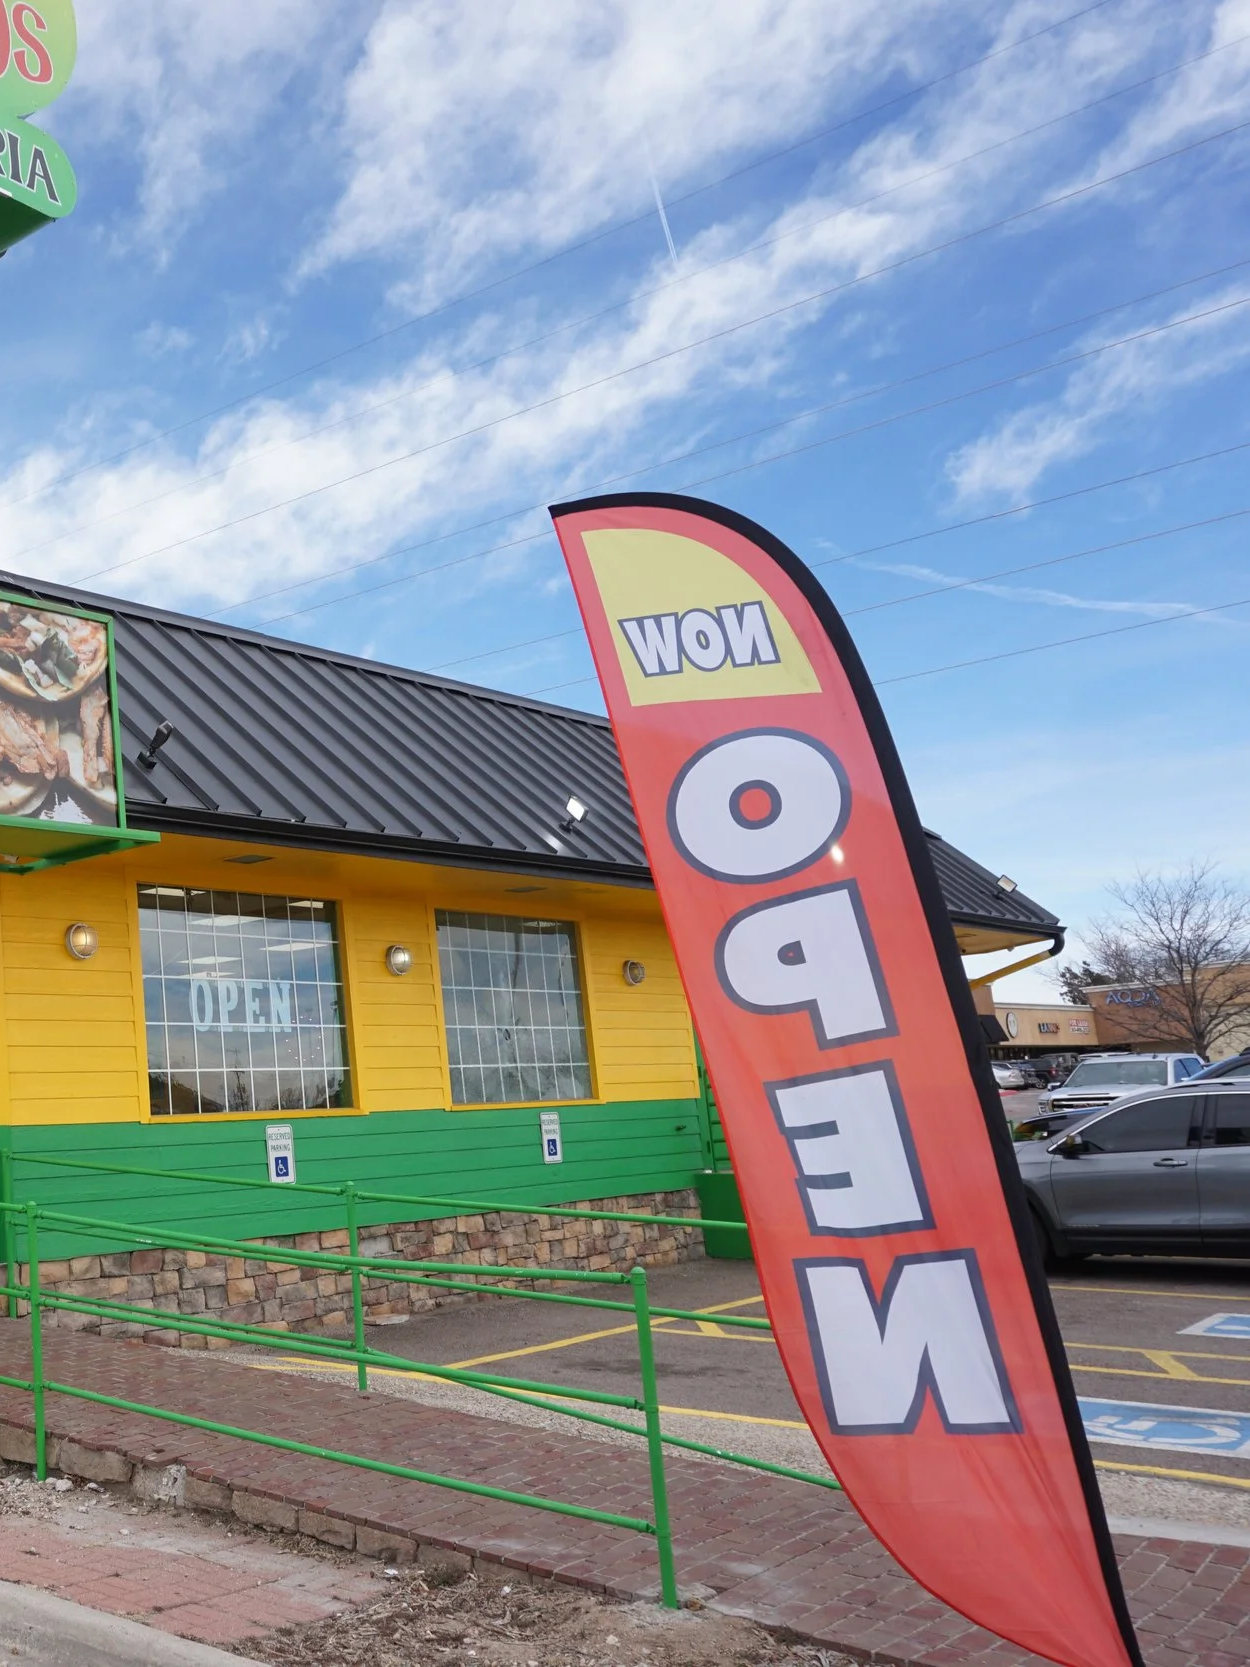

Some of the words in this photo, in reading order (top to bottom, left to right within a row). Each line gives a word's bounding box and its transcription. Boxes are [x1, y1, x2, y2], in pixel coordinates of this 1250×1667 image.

[189, 979, 291, 1032] OPEN
[268, 1132, 290, 1140] RESERVED
[270, 1144, 290, 1152] PARKING
